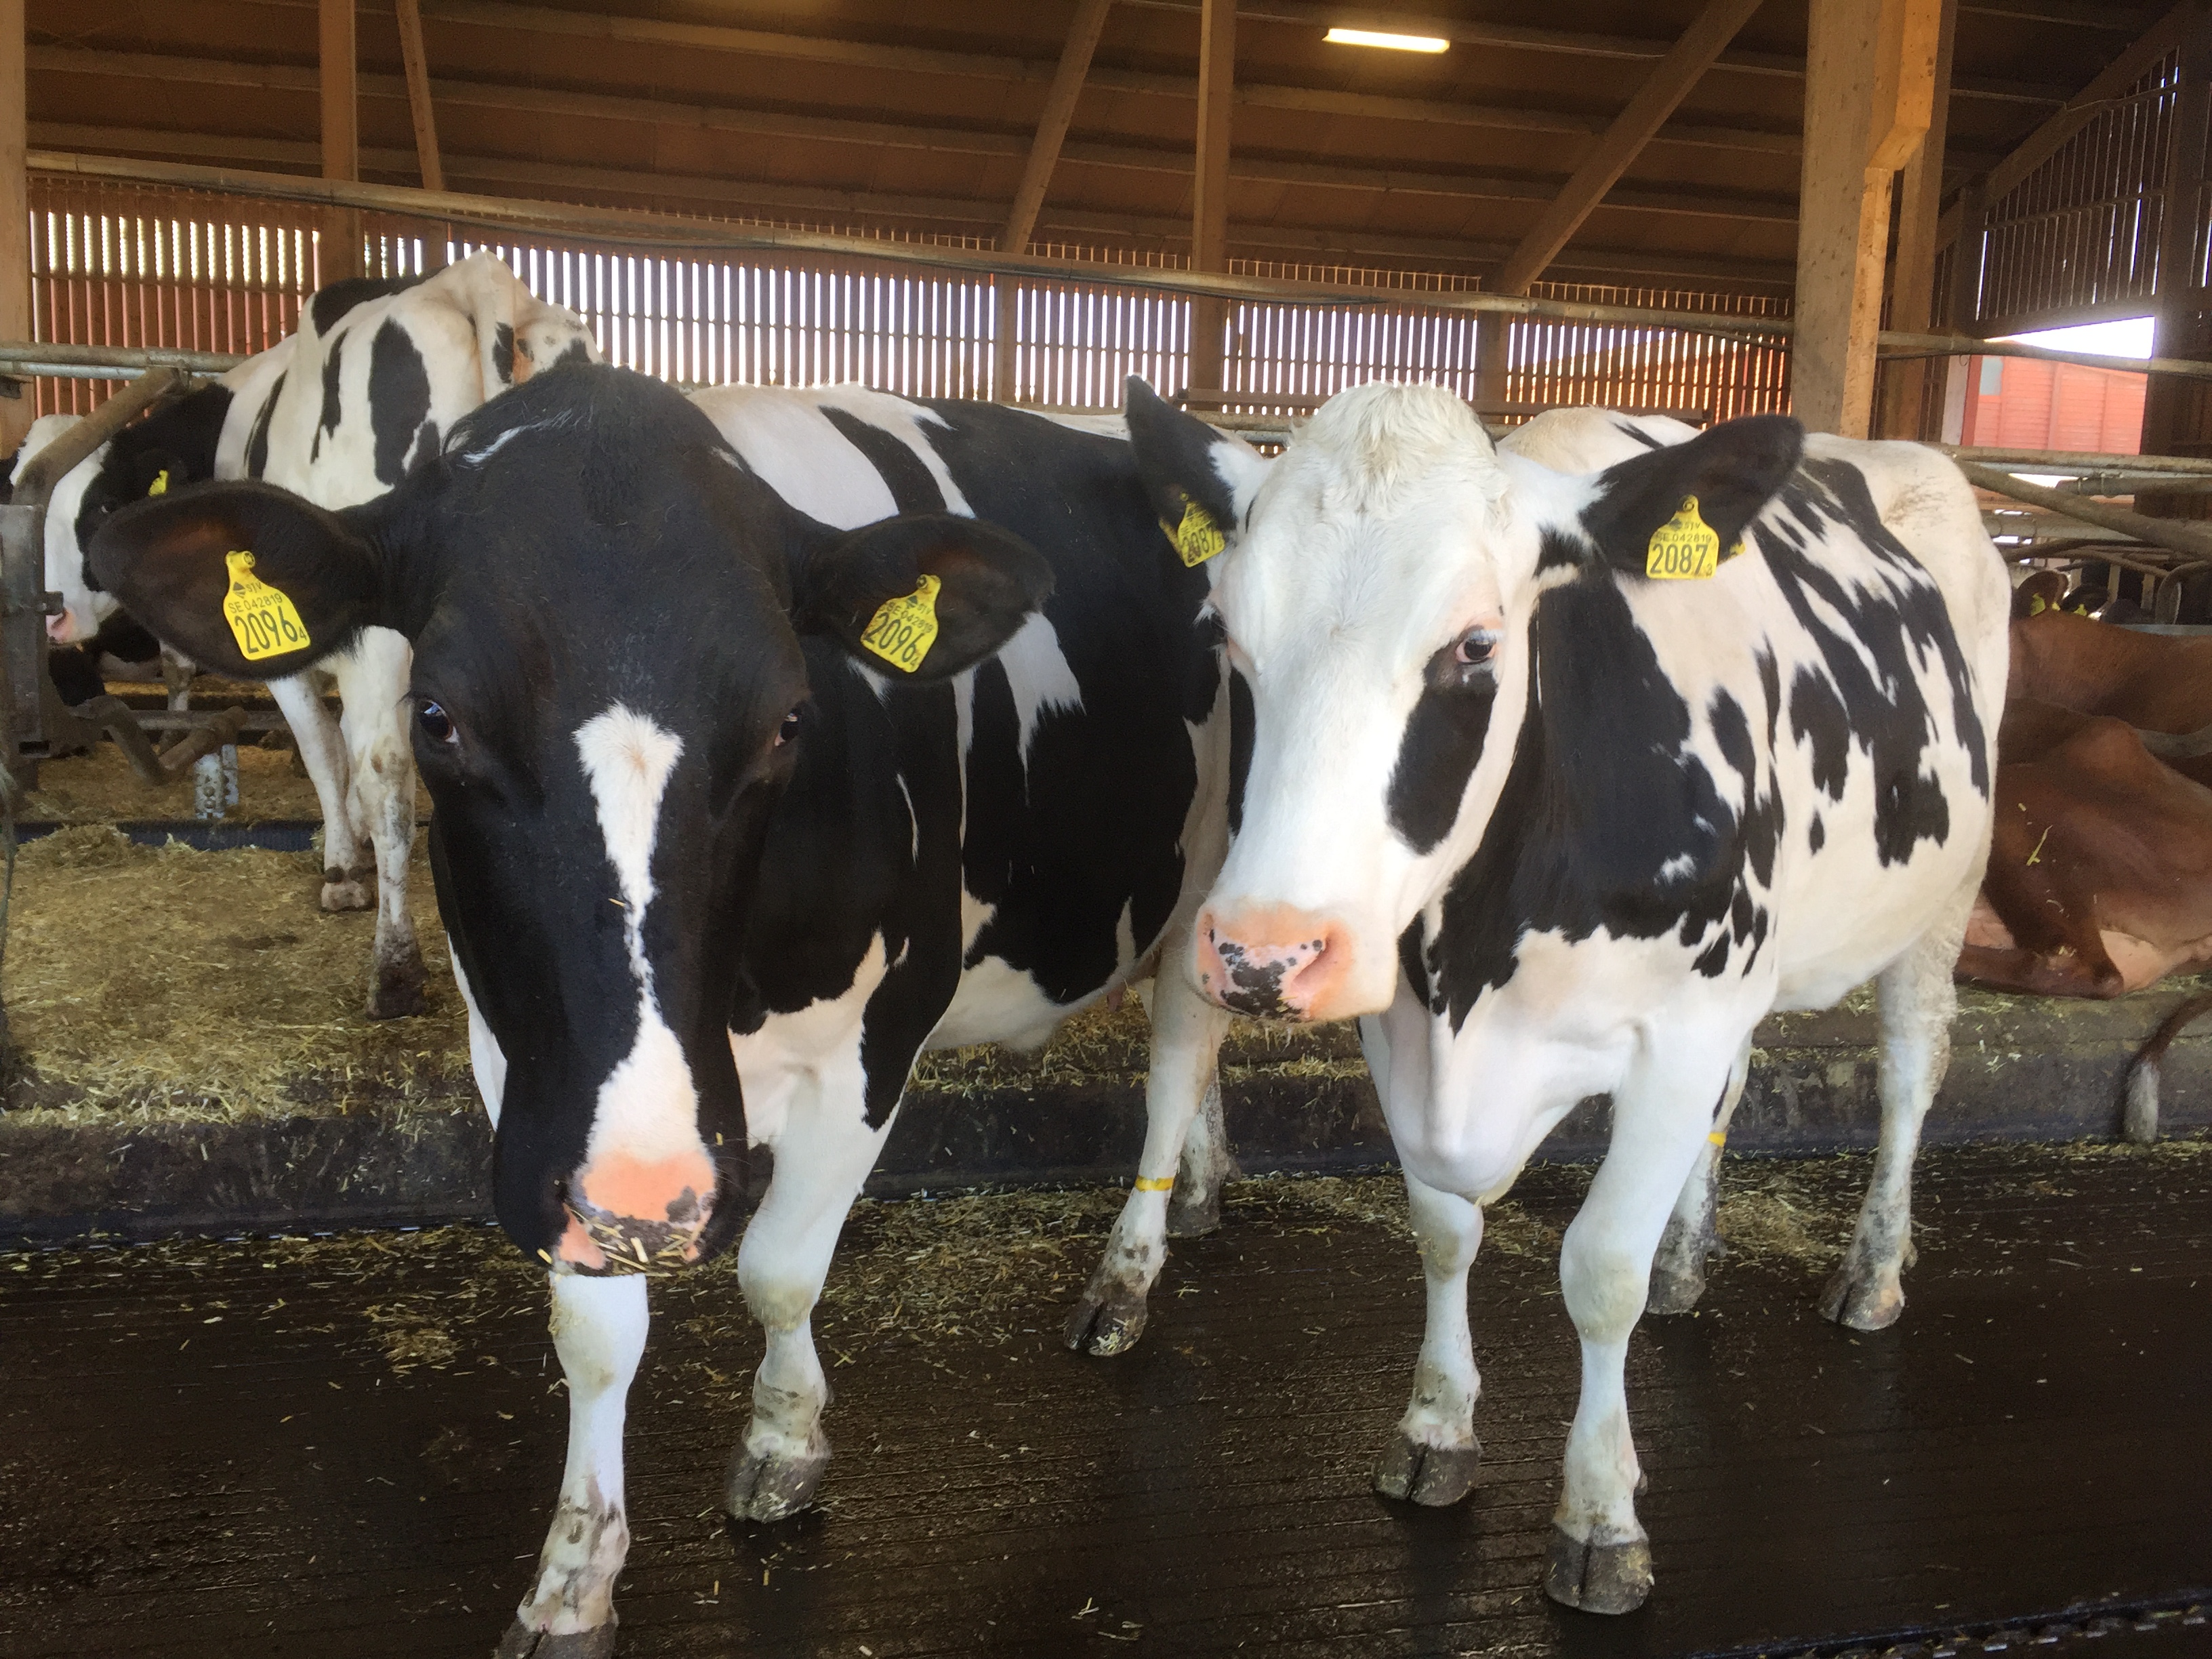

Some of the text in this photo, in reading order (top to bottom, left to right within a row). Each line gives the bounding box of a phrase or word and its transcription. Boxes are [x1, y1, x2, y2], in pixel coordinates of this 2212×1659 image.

[1650, 544, 1708, 575] 2087
[228, 593, 283, 613] SE 042819
[234, 605, 308, 653] 2096 4
[864, 612, 924, 663] 2096
